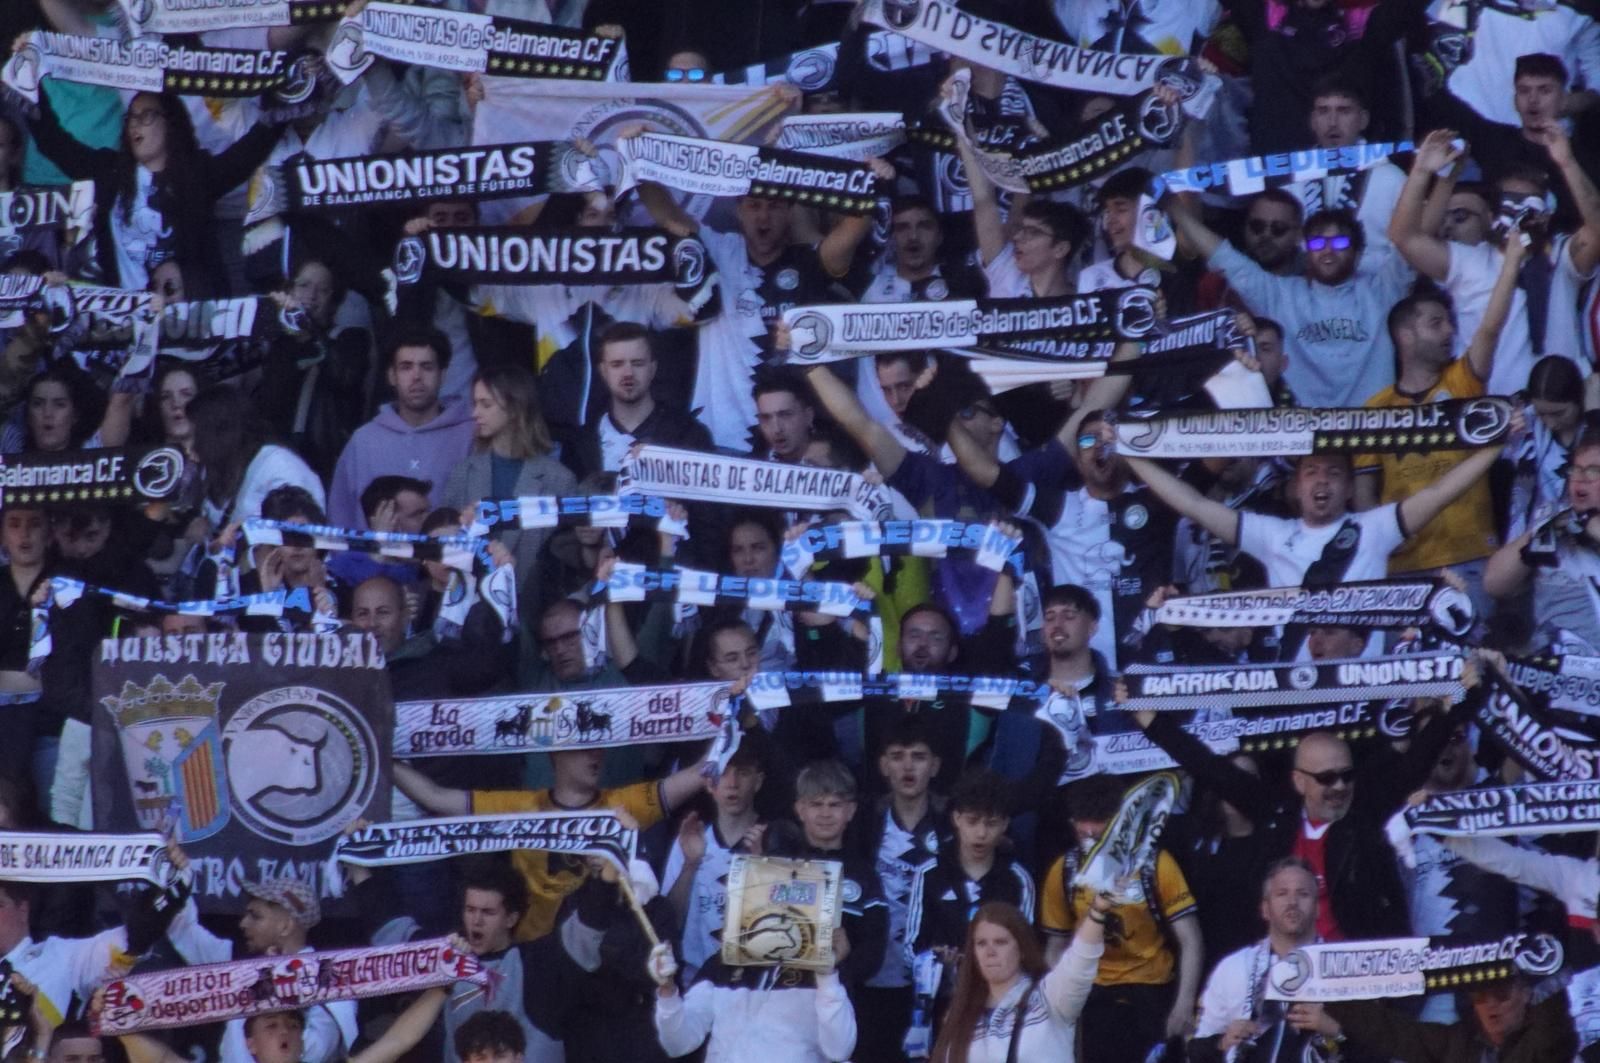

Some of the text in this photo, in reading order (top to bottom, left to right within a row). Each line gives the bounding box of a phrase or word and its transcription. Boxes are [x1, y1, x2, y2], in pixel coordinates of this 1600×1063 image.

[363, 8, 458, 48] UNIONISTAS
[459, 23, 481, 49] de
[482, 24, 582, 60] Salamanca
[40, 31, 287, 75] UNIONISTAS de Salamanca C.F.
[1013, 132, 1104, 177] Salamanca
[1100, 114, 1134, 146] C.F.
[299, 147, 536, 196] UNIONISTAS
[627, 137, 722, 176] UNIONISTAS
[723, 152, 744, 179] de
[746, 155, 847, 192] Salamanca
[303, 194, 322, 206] DE
[326, 188, 413, 206] SALAMANCA
[418, 184, 453, 198] CLUB
[458, 182, 476, 195] DE
[429, 234, 667, 274] UNIONISTAS
[843, 297, 1109, 343] UNIONISTAS de Salamanca C.F.
[1177, 408, 1281, 435] UNIONISTAS
[1283, 407, 1308, 433] de
[1309, 407, 1415, 432] Salamanca
[96, 456, 127, 482] C.F.
[630, 456, 721, 490] UNIONISTAS
[728, 465, 748, 492] DE
[752, 467, 854, 498] SALAMANCA
[101, 632, 251, 667] NUESTRA
[1142, 669, 1279, 696] BARRIKADA
[648, 690, 682, 715] del
[410, 724, 475, 753] grada
[629, 712, 695, 738] barrio
[1210, 720, 1233, 742] de
[1232, 710, 1336, 737] Salamanca
[1338, 702, 1372, 723] C.F.
[1458, 808, 1506, 834] que
[1508, 803, 1569, 825] llevo
[23, 844, 114, 870] SALAMANCA
[118, 846, 140, 869] CF
[1319, 949, 1401, 979] UNIONISTAS
[1401, 948, 1419, 974] de
[1419, 942, 1501, 971] Salamanca
